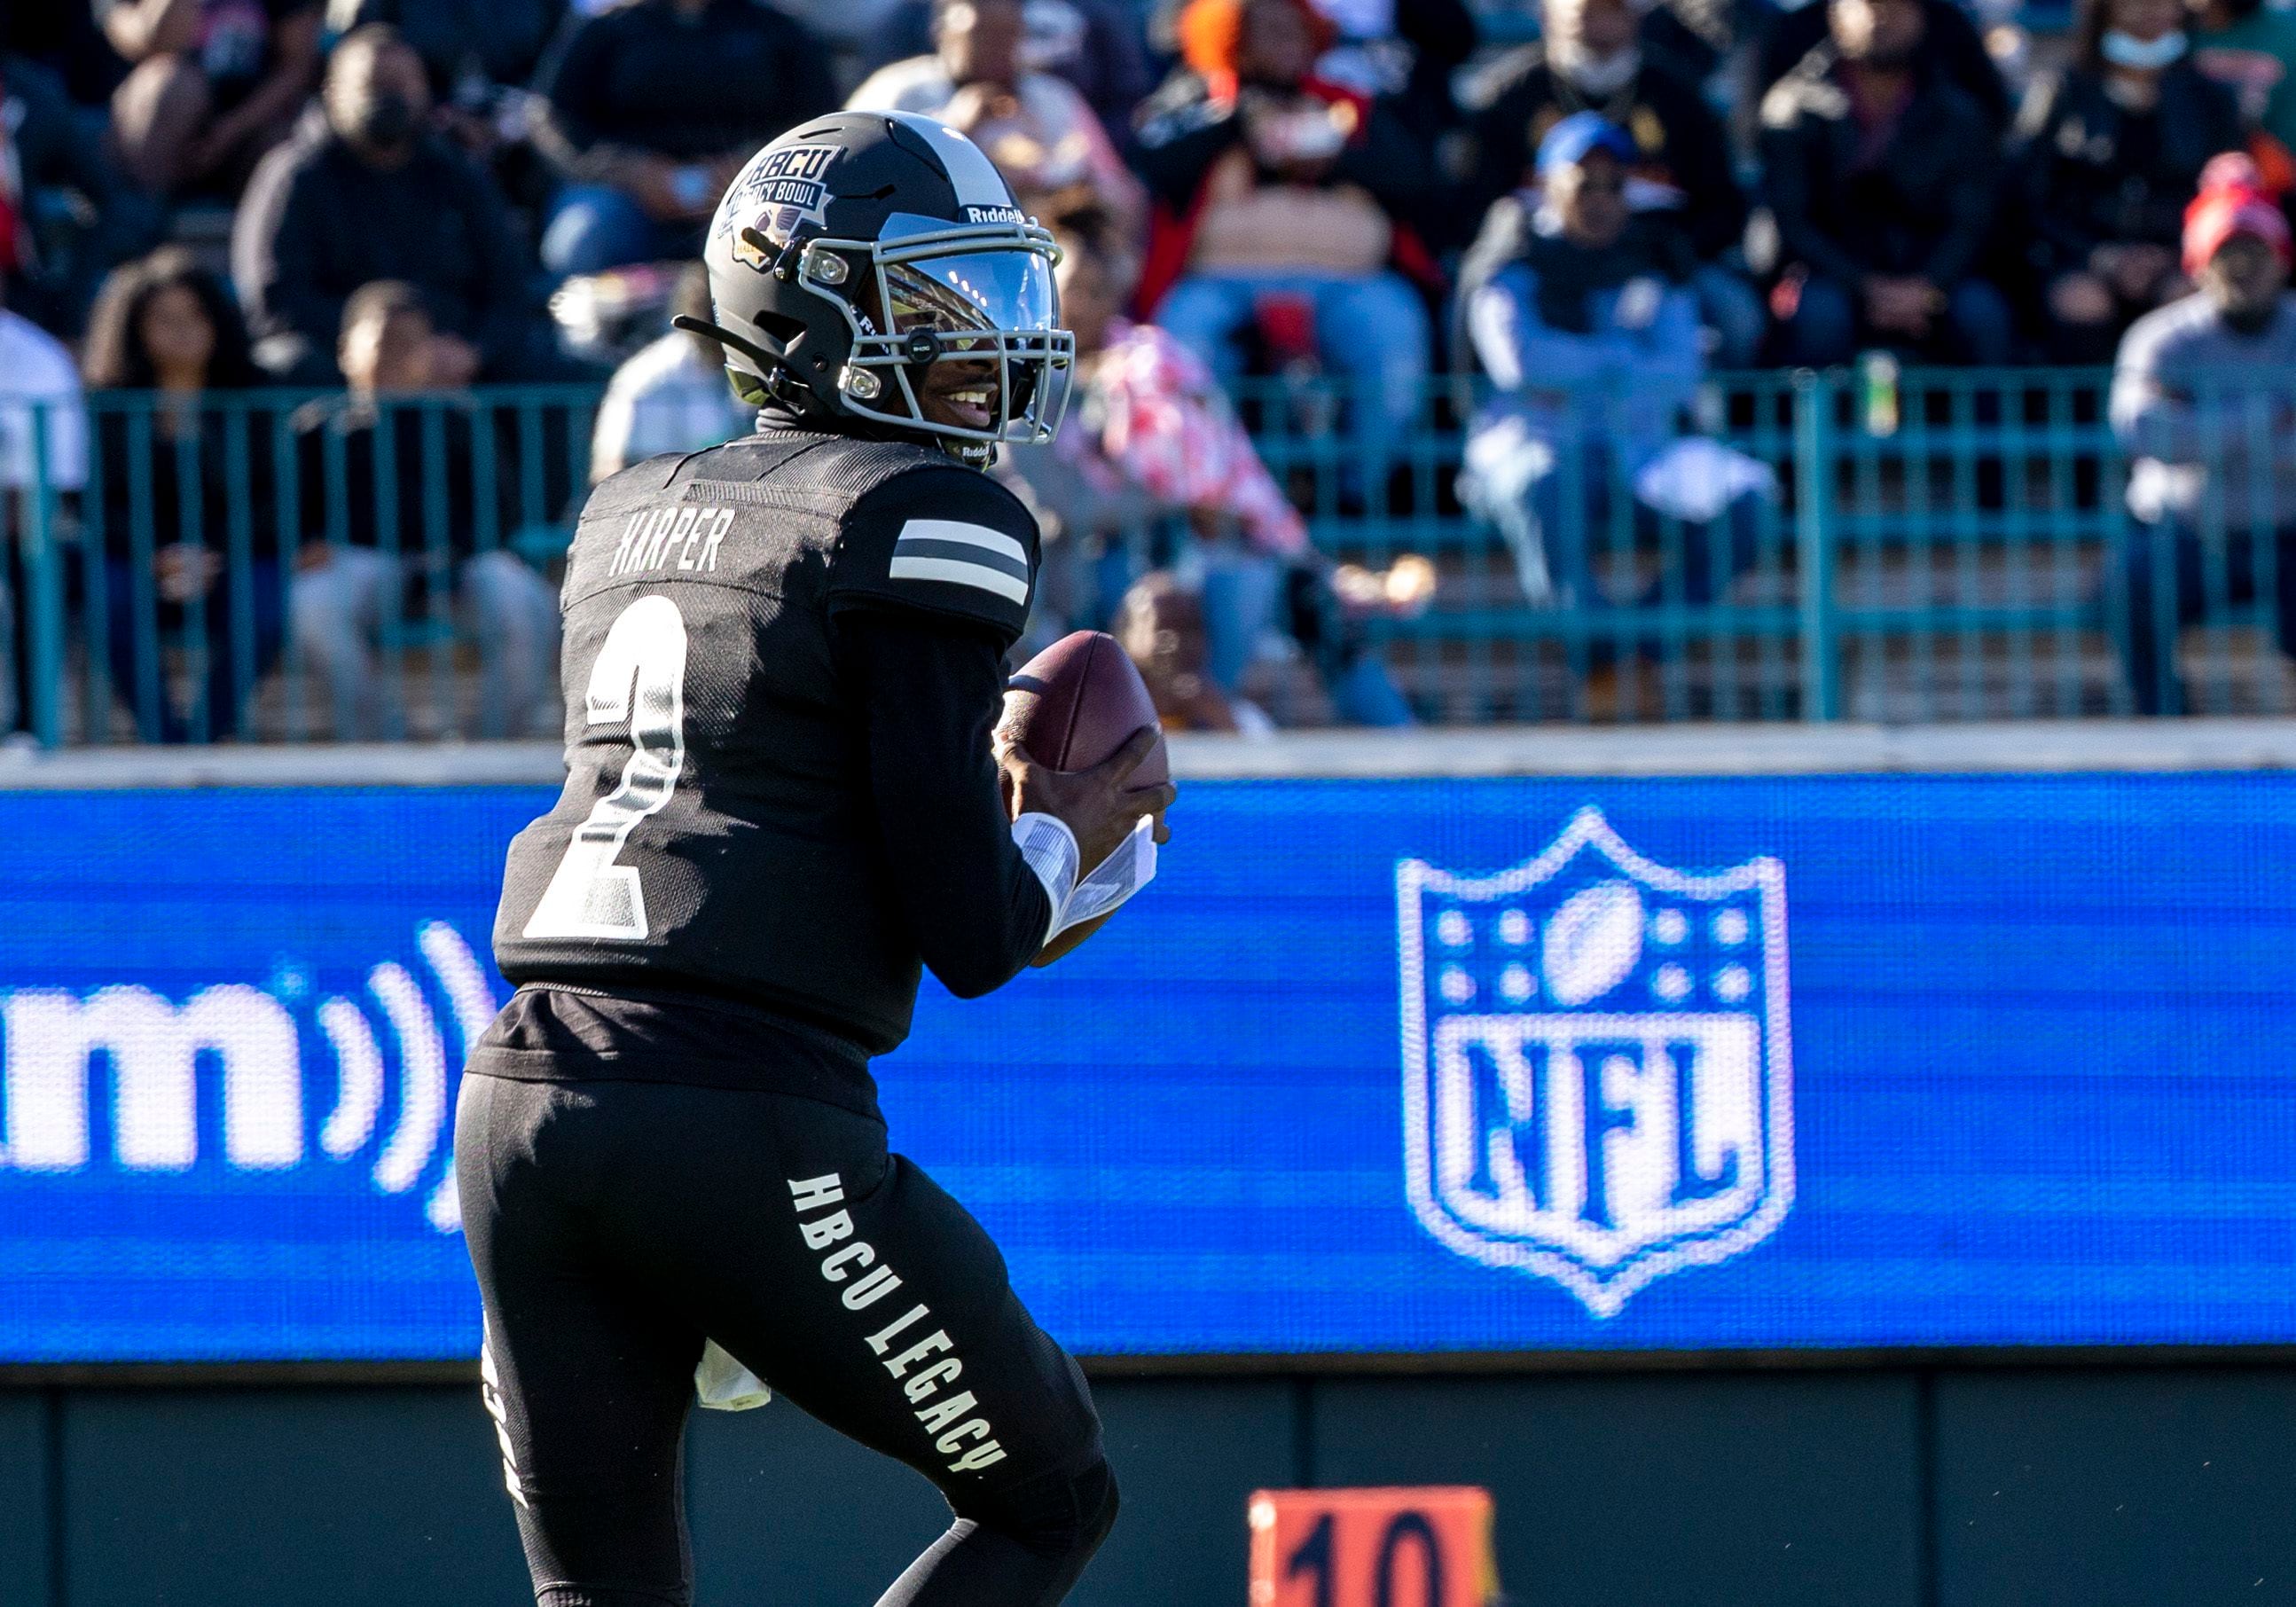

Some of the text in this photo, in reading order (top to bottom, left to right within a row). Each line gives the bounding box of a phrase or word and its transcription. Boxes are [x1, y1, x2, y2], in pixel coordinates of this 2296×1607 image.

[747, 148, 833, 184] HBCU
[774, 181, 816, 207] BOWL
[966, 207, 1024, 224] Riddell
[607, 506, 736, 577] HARPER
[522, 594, 687, 939] 2
[0, 983, 304, 1172] m
[1463, 1040, 1740, 1230] NFL
[788, 1172, 1007, 1472] HBCU LEGACY
[1288, 1509, 1446, 1607] 10
